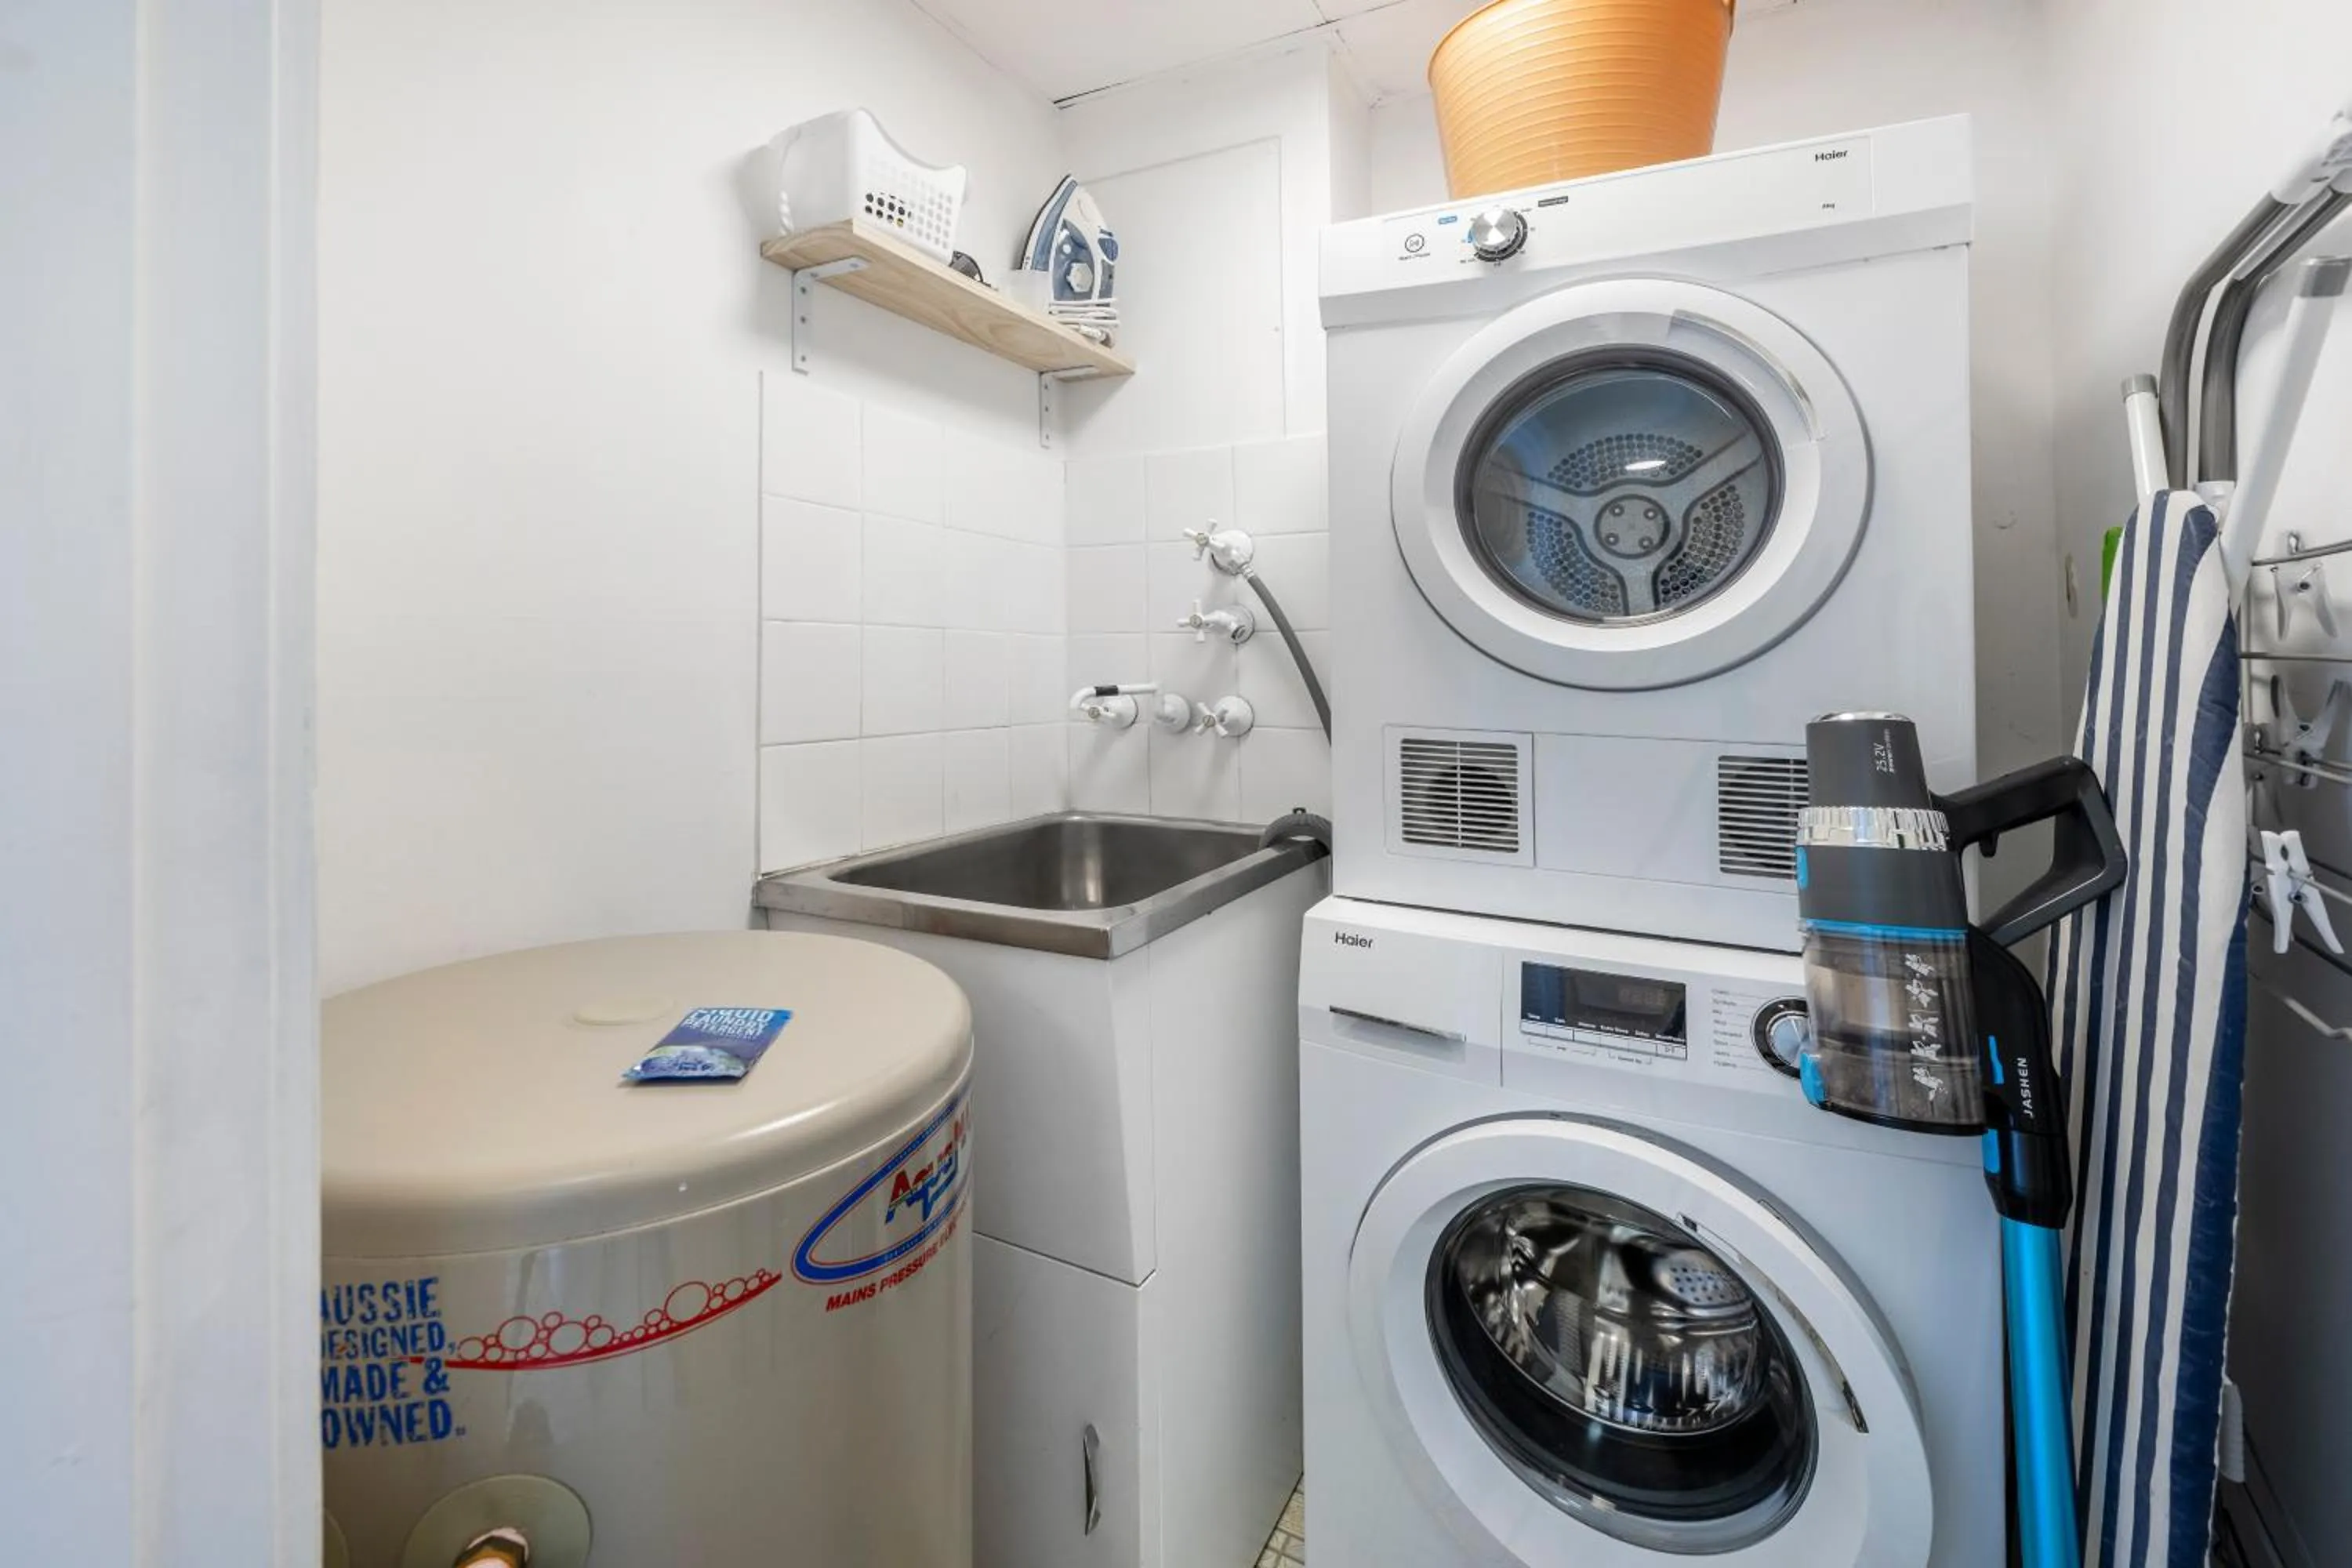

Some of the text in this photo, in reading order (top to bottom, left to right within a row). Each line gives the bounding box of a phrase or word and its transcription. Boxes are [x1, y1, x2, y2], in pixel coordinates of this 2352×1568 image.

[1815, 150, 1848, 162] Haier
[1873, 742, 1888, 773] 25.2V
[1334, 931, 1374, 949] Haier
[689, 1011, 769, 1032] LAUNDRY
[2016, 1057, 2034, 1120] JASHEN
[826, 1242, 939, 1312] MAINS PRESSURE
[321, 1321, 456, 1360] ESIGNED,
[321, 1356, 451, 1403] MADE &
[321, 1398, 466, 1450] OWNED.
